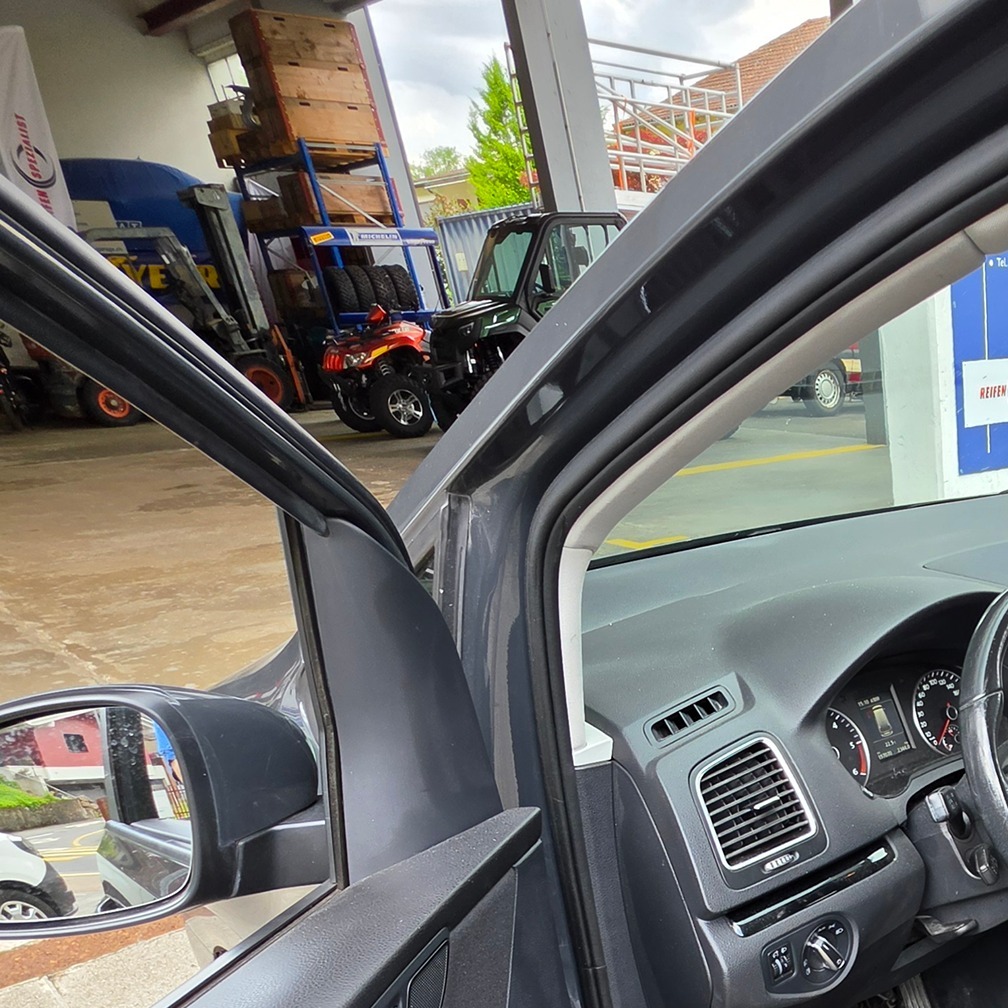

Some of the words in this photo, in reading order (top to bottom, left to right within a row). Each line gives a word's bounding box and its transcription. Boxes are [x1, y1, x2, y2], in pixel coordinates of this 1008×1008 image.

[14, 112, 43, 179] SPEZIALIST
[359, 233, 399, 241] MICHELIN
[996, 257, 1008, 267] Tel.
[979, 384, 1007, 400] REIFEN
[832, 721, 838, 729] 4
[849, 741, 855, 749] 5
[852, 767, 859, 776] 6
